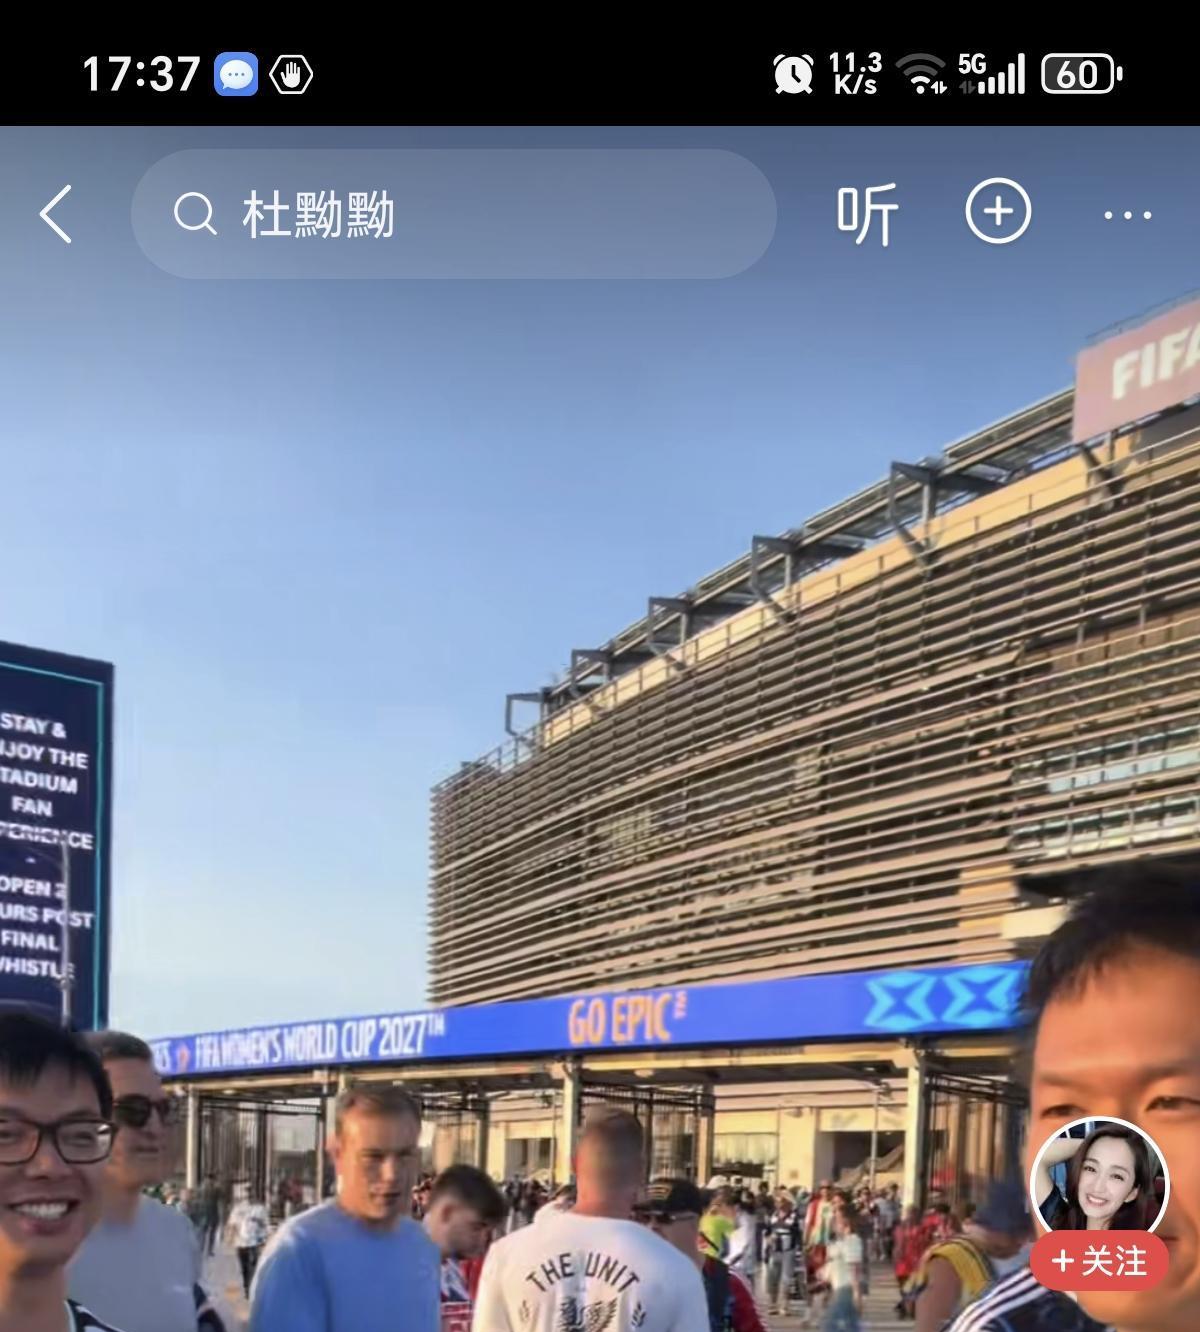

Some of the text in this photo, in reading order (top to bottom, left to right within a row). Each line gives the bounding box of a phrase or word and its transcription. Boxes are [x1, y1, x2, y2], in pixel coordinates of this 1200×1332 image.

[0, 712, 67, 739] STAY &
[48, 747, 89, 769] THE
[12, 795, 53, 818] FAN
[0, 875, 52, 898] OPEN
[1, 929, 60, 951] FINAL
[568, 997, 606, 1046] GO
[284, 1022, 338, 1062] WORLD
[341, 1017, 377, 1059] CUP
[525, 1251, 640, 1293] THE UNIT
